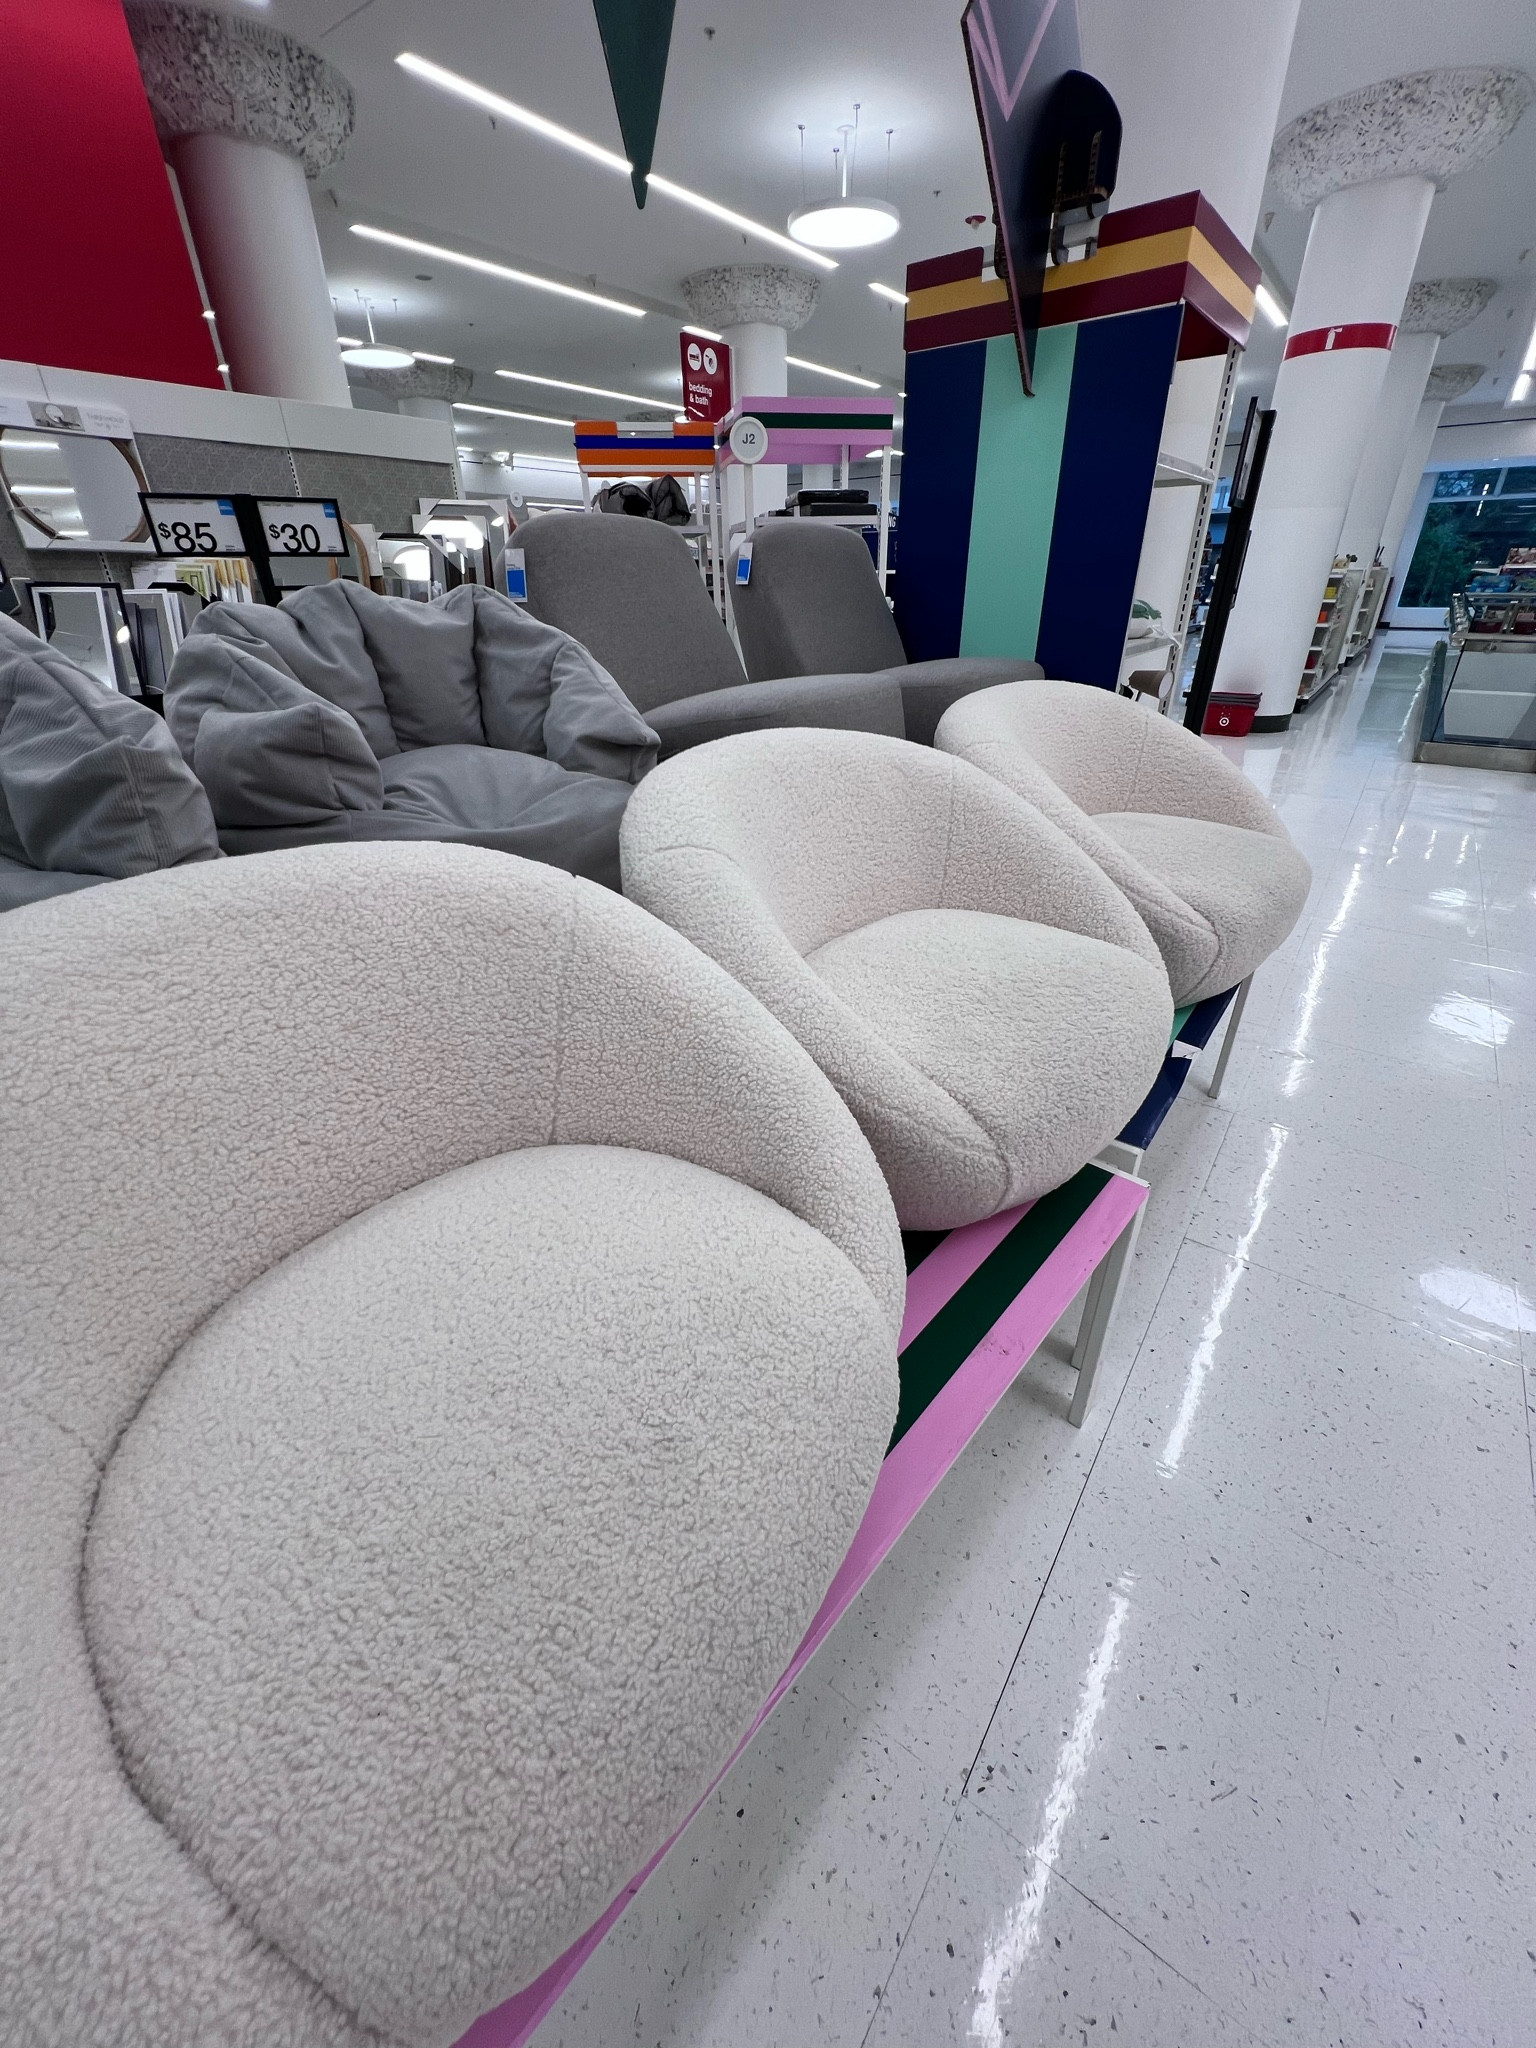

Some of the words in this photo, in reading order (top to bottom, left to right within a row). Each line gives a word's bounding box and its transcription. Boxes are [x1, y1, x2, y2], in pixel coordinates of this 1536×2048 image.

[689, 382, 712, 397] bedding
[690, 393, 694, 403] &
[695, 395, 708, 405] bath
[742, 433, 756, 445] J2
[157, 521, 218, 552] $85
[268, 523, 321, 552] $30
